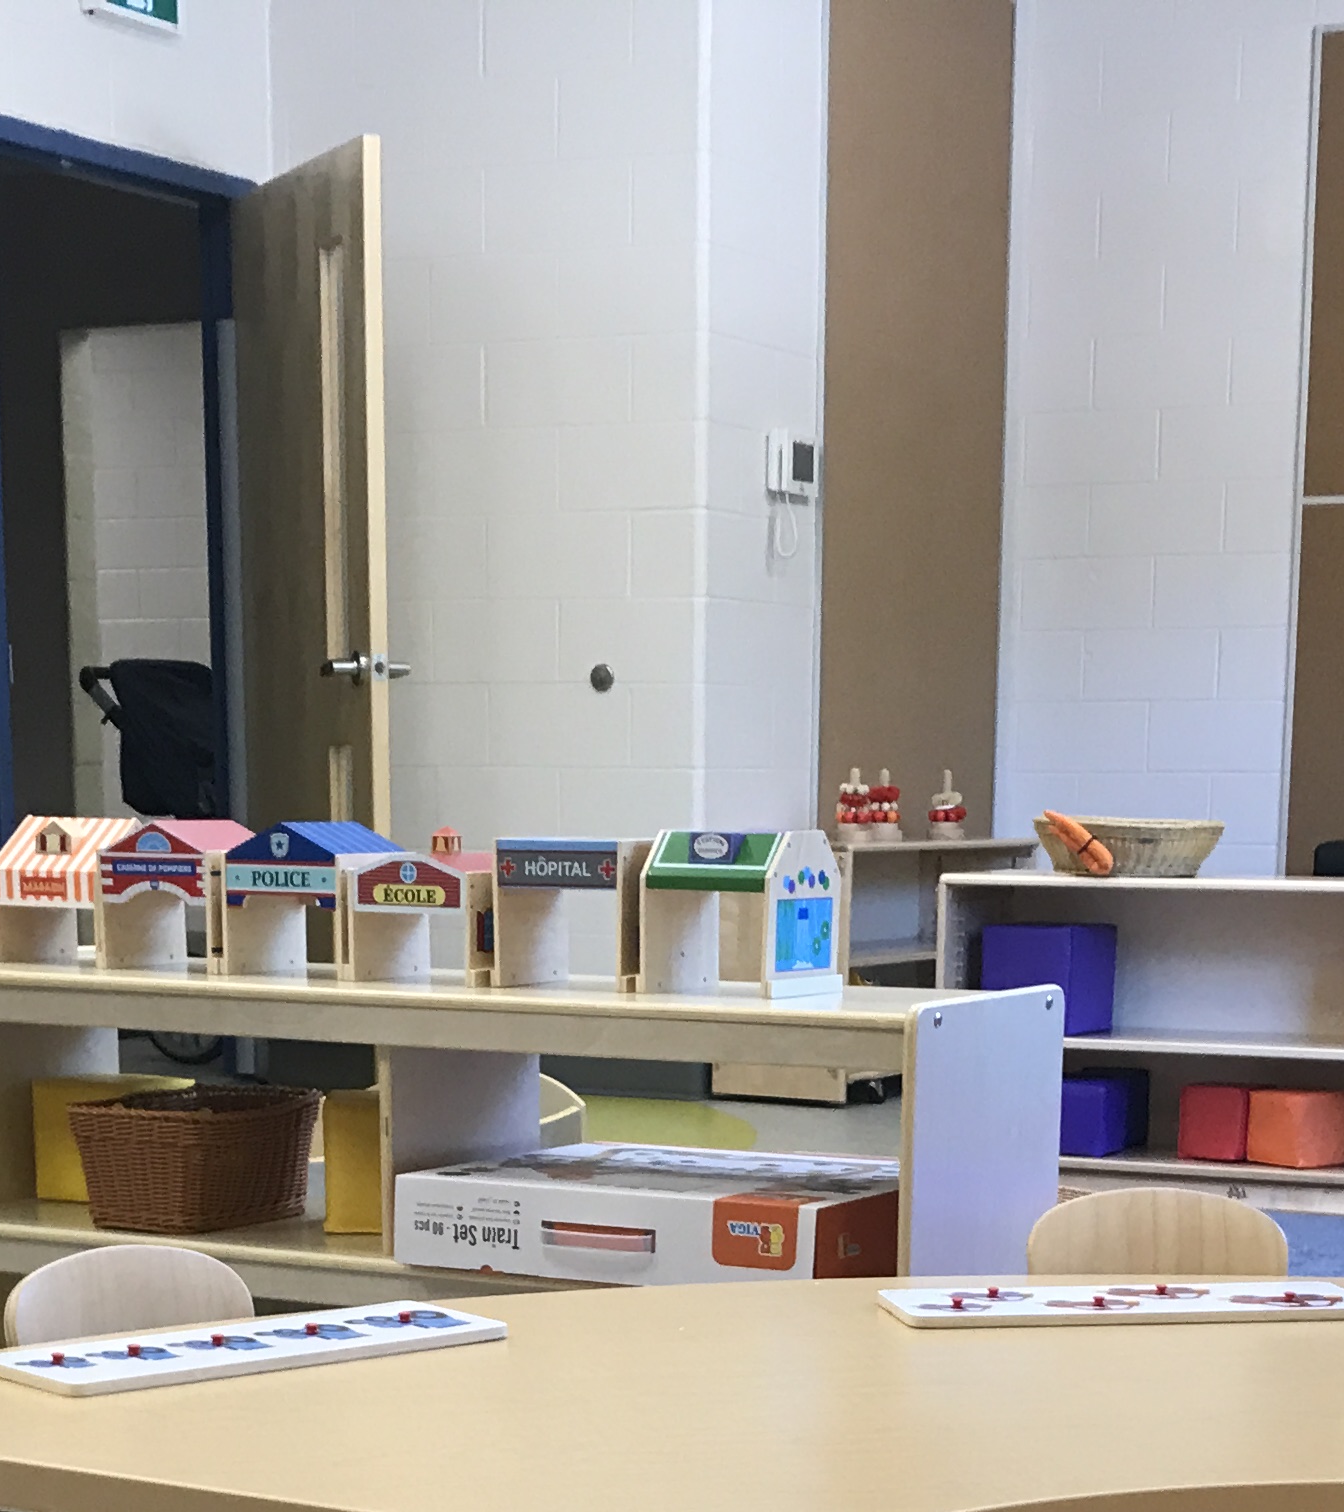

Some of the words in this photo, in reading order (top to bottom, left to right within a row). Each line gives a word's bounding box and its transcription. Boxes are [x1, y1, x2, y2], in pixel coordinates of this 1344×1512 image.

[524, 855, 592, 878] HÔPITAL
[252, 870, 311, 888] POLICE
[383, 884, 437, 904] ÉCOLE
[414, 1219, 430, 1232] pcs
[432, 1221, 444, 1236] 90
[453, 1223, 478, 1247] Set
[729, 1222, 761, 1236] VIGA
[481, 1226, 521, 1251] Train
